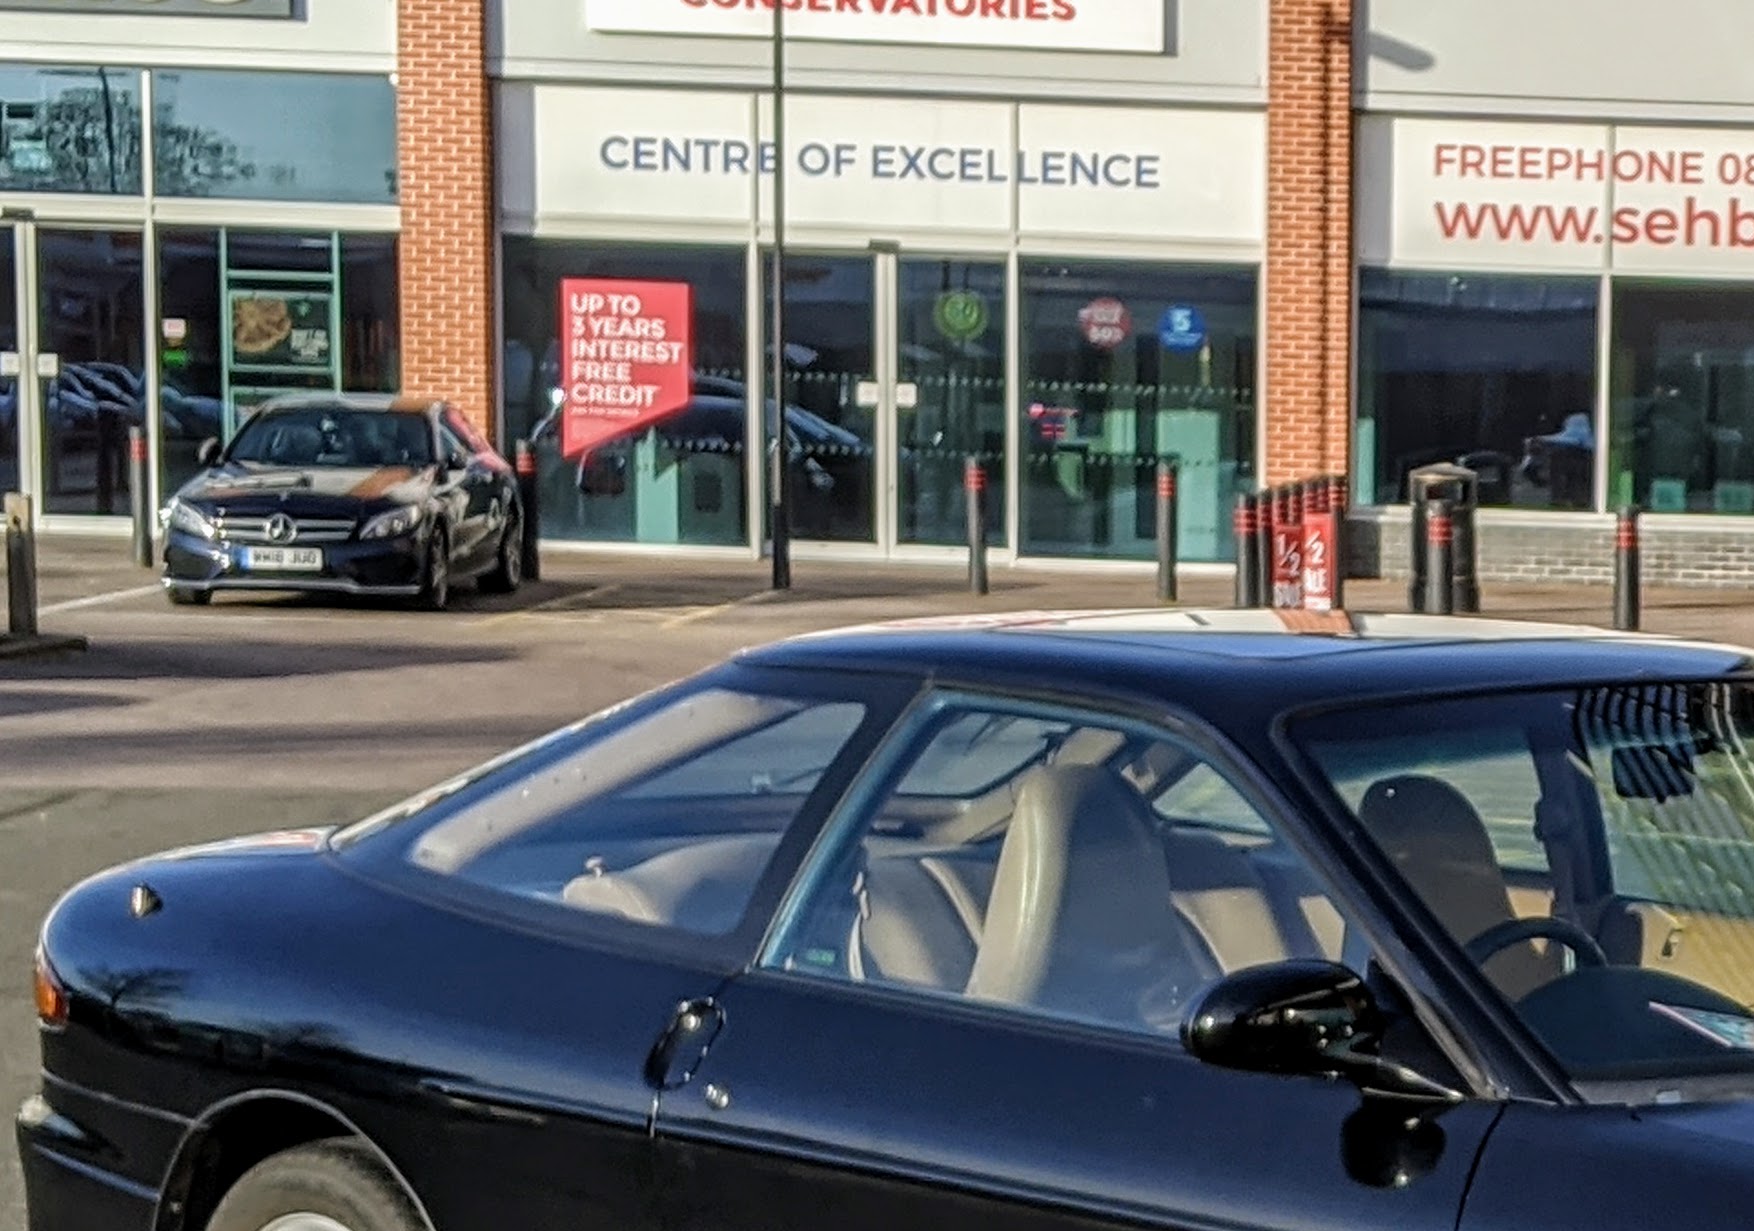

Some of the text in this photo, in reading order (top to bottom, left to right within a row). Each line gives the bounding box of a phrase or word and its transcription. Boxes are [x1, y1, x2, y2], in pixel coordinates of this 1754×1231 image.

[680, 0, 1076, 21] ATORIES
[600, 135, 1161, 189] CENTRE OF EXCELLENCE
[1433, 143, 1705, 184] FREEPHONE
[570, 293, 642, 316] UP TO
[571, 316, 667, 340] 3 YEARS
[571, 338, 684, 364] INTEREST
[571, 360, 633, 384] FREE
[571, 382, 662, 407] CREDIT
